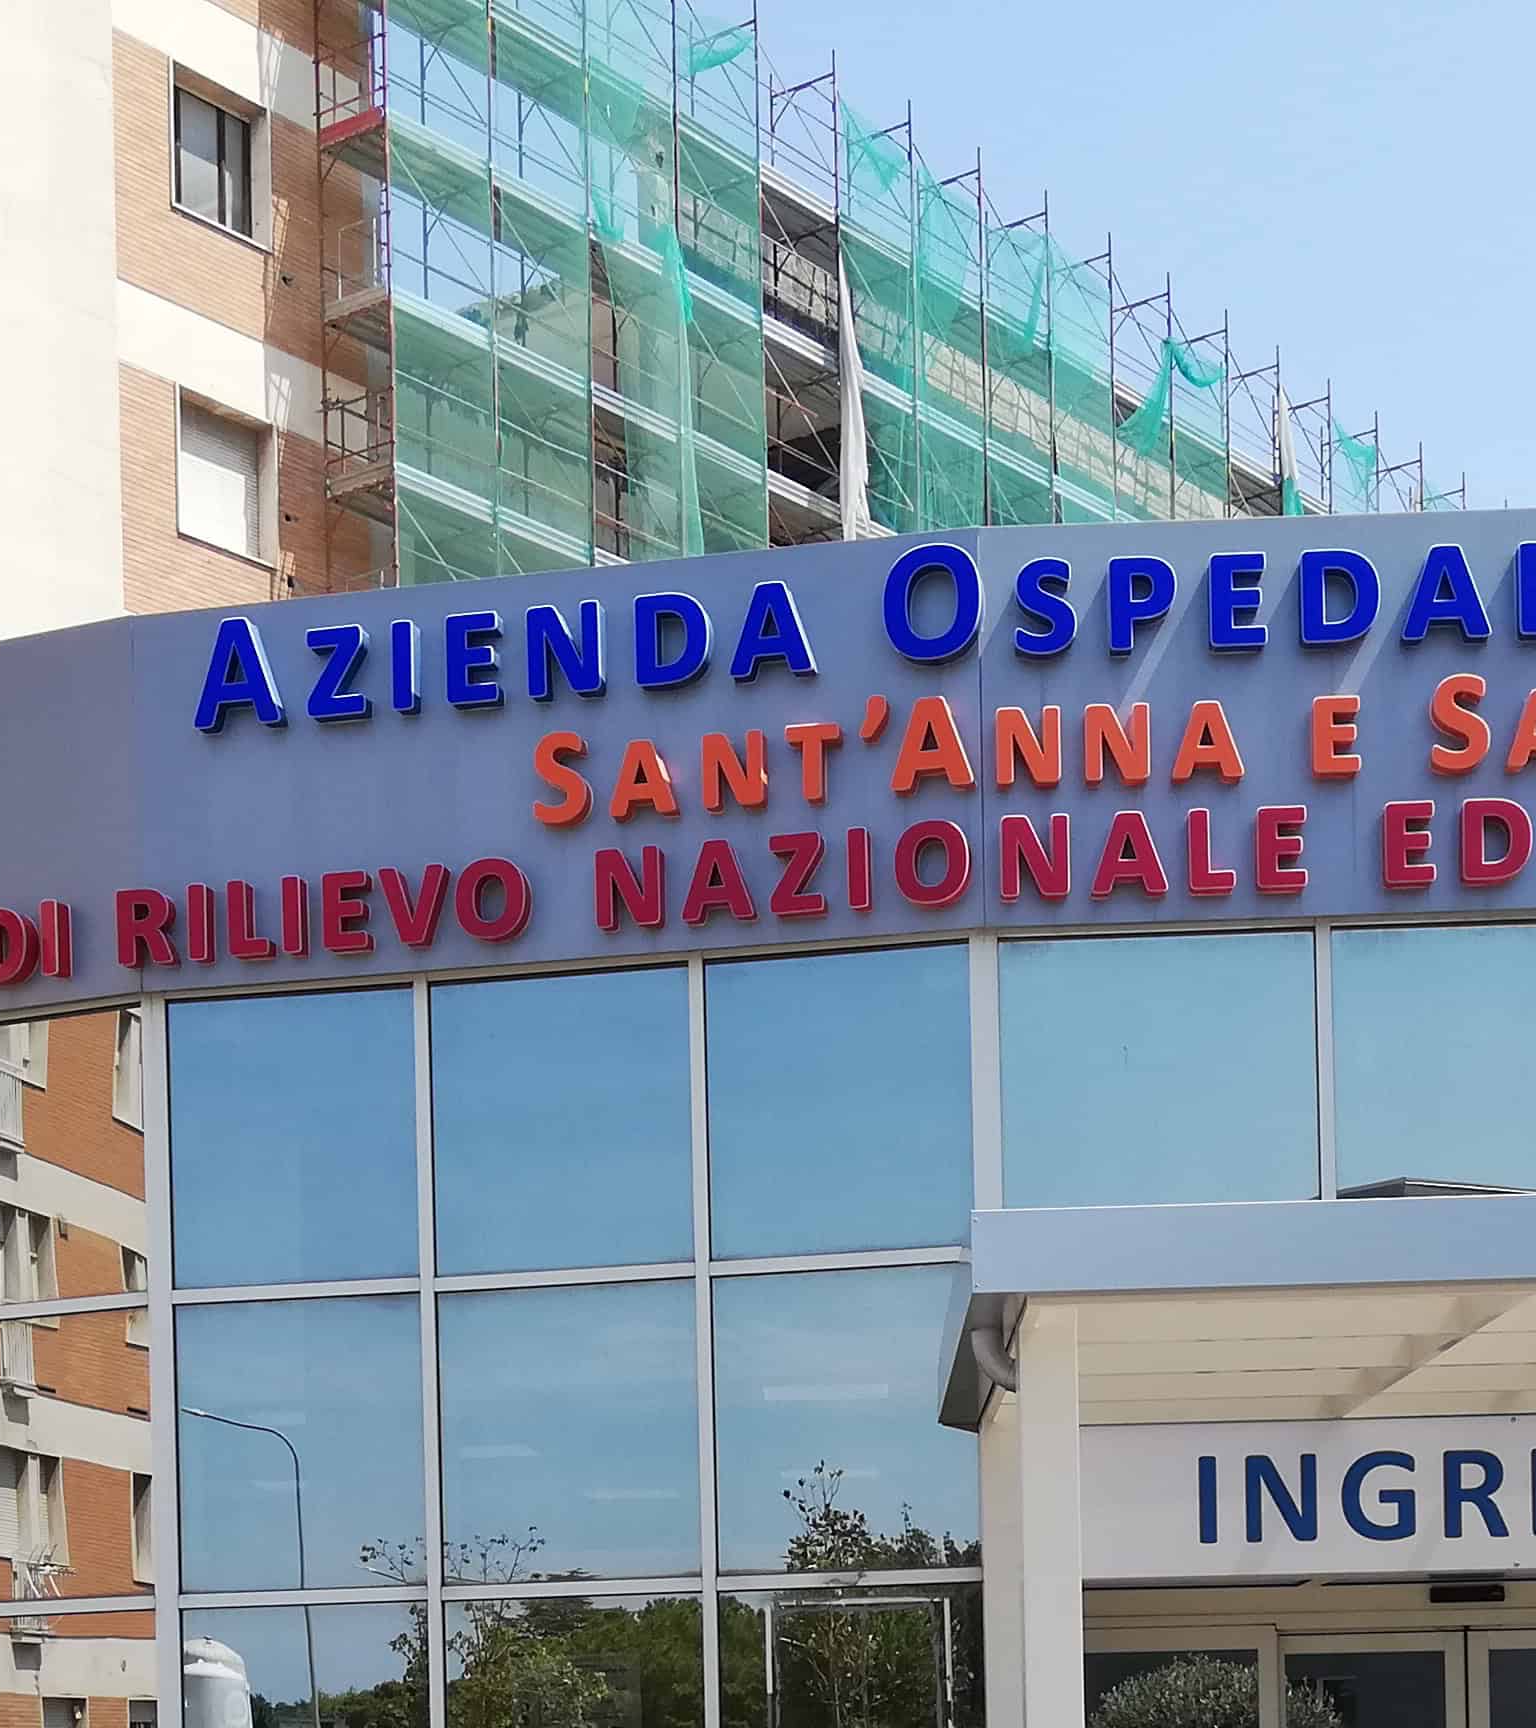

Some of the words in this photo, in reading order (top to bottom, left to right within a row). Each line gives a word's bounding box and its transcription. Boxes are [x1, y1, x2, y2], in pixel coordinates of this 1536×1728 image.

[194, 579, 817, 734] AZIENDA
[1311, 693, 1362, 780] E
[116, 856, 533, 969] RILIEVO
[594, 804, 1310, 933] NAZIONALE
[1381, 798, 1533, 890] ED
